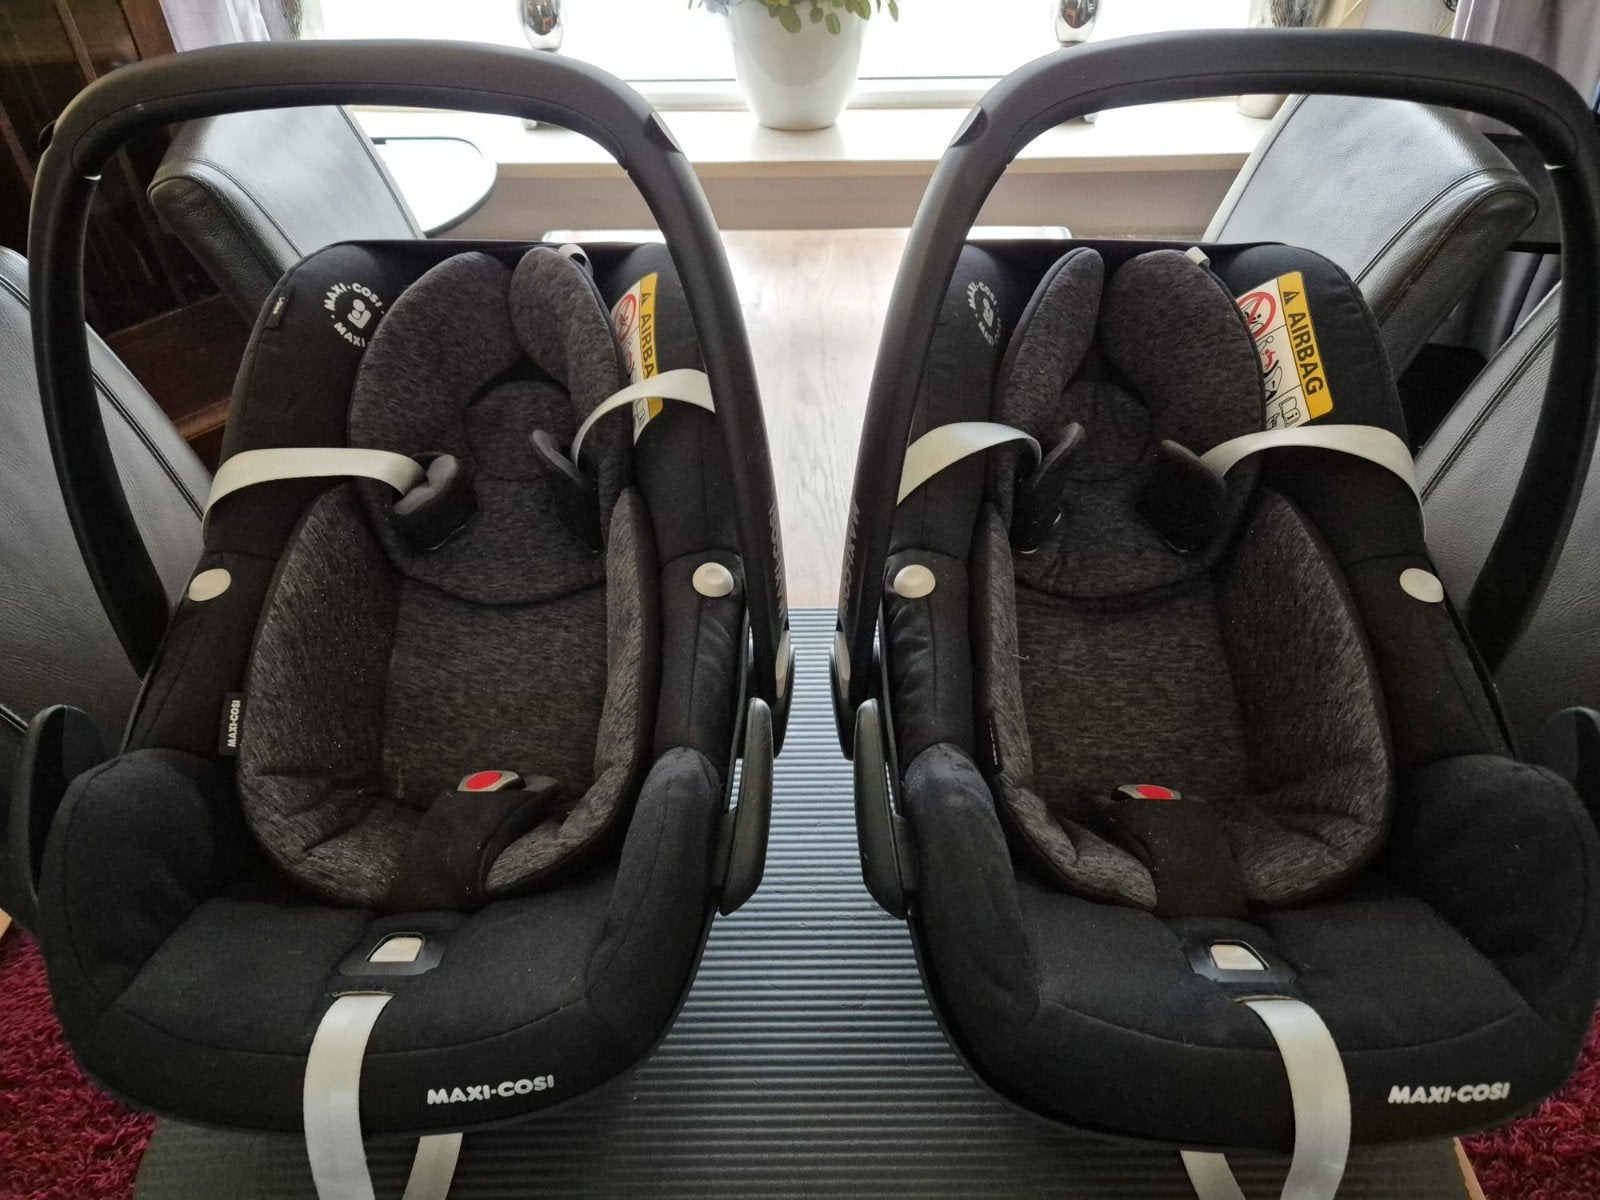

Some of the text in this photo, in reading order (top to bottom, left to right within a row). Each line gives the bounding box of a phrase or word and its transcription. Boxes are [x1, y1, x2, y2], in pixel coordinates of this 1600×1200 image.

[641, 313, 655, 379] AIRBA
[1288, 312, 1324, 396] AIRBAG
[227, 700, 241, 748] MAXI-COSI
[426, 1074, 555, 1105] MAXI-COSI
[1387, 1082, 1511, 1104] MAXI-COSI
